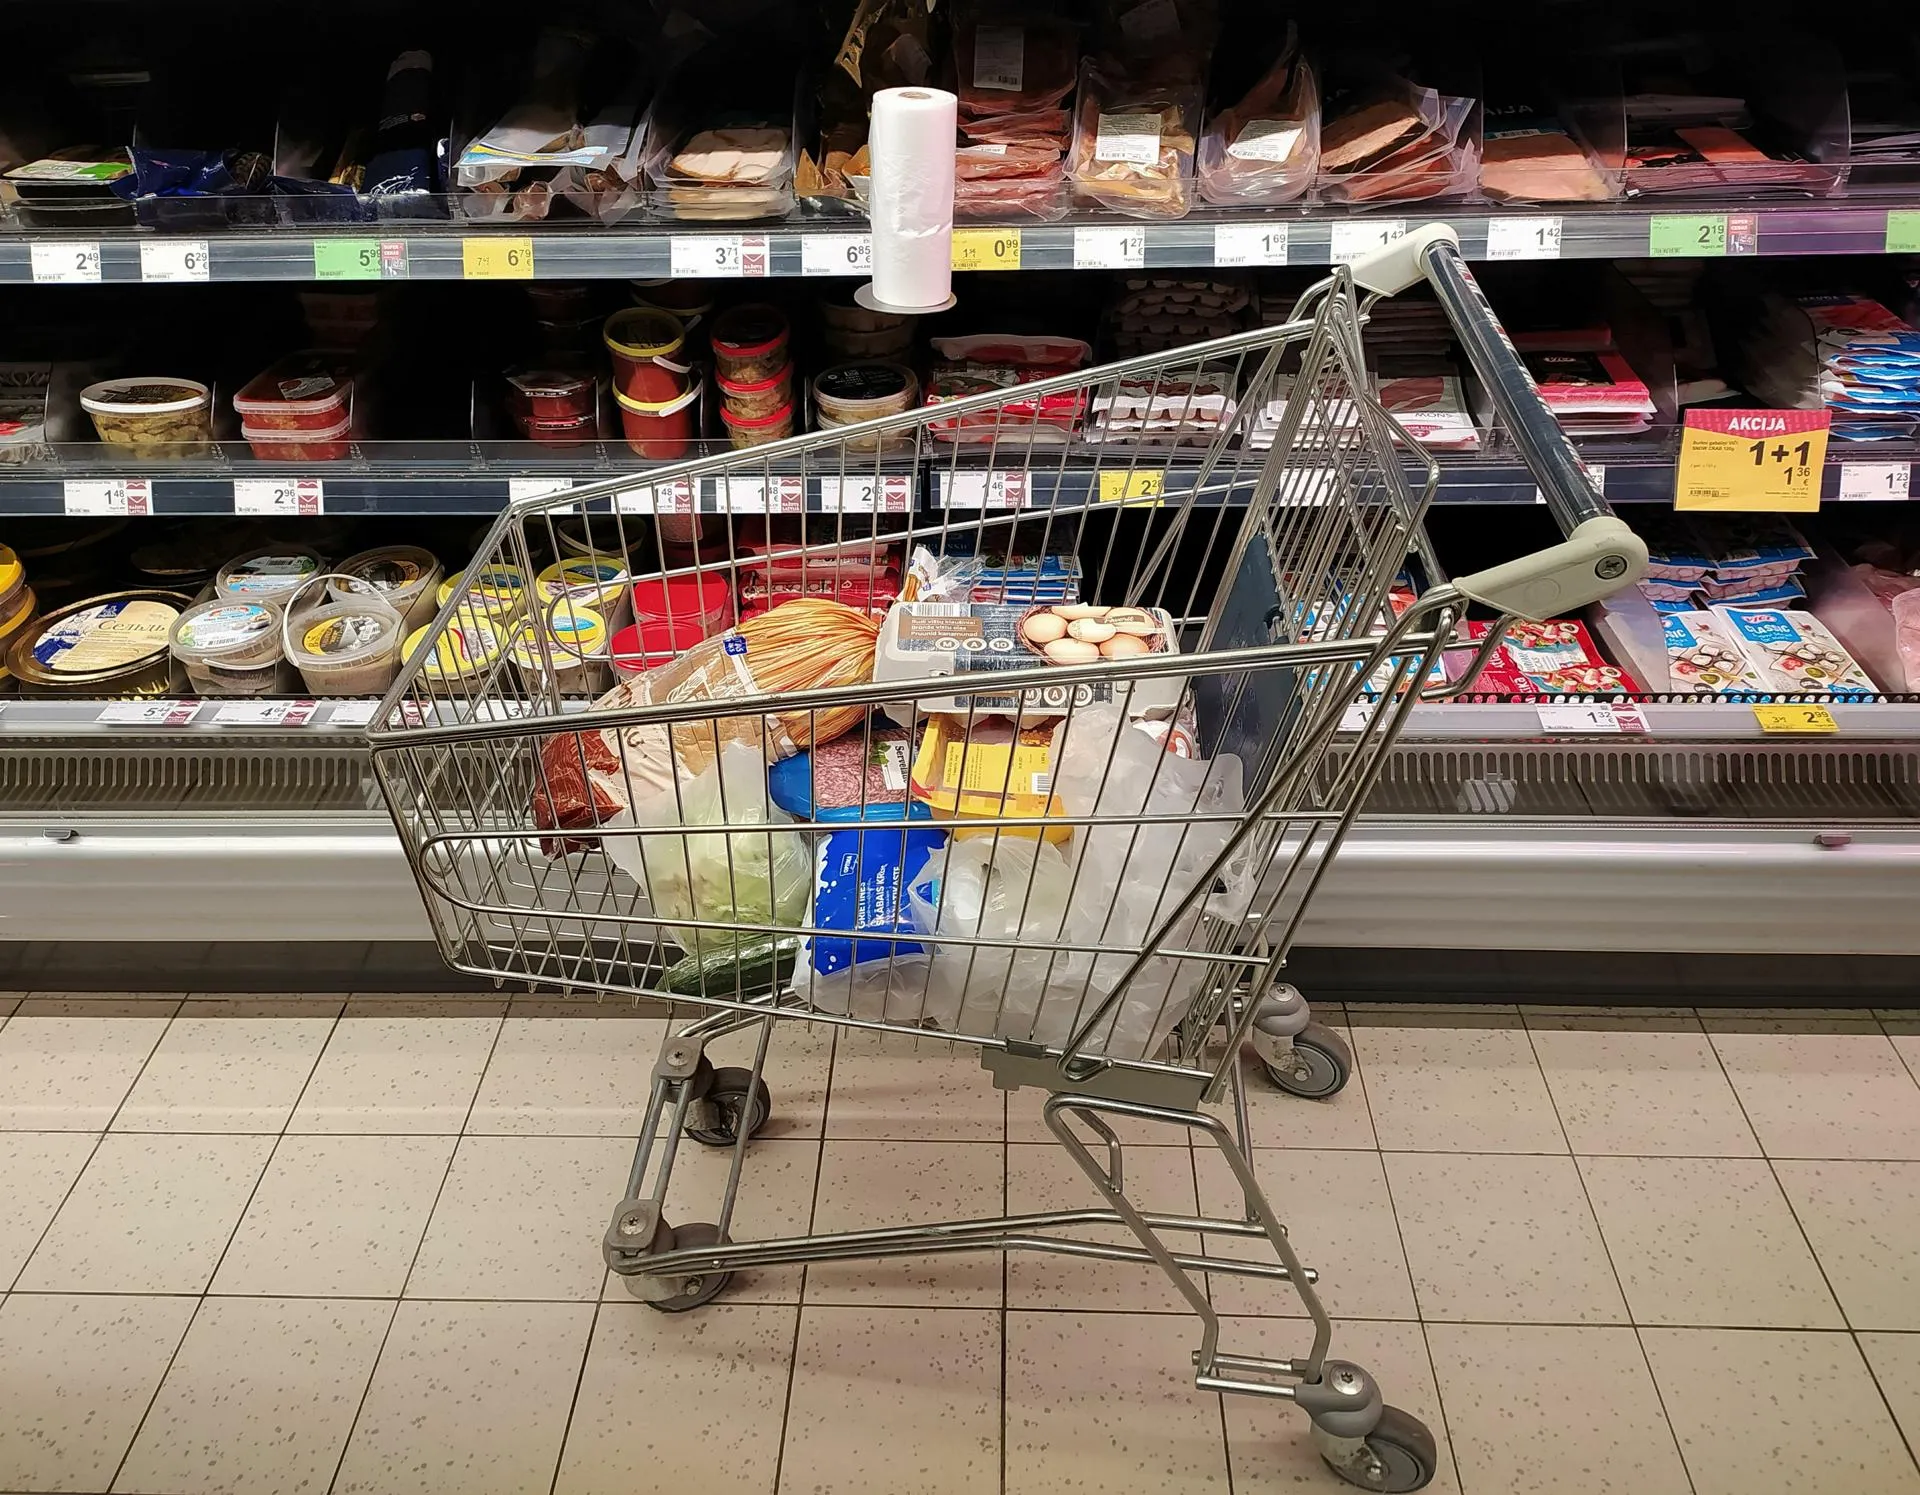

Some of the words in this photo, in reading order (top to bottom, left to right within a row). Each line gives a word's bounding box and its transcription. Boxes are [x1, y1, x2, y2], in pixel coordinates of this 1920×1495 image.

[1535, 228, 1560, 246] 142
[1698, 224, 1724, 243] 219
[994, 240, 1018, 257] 099
[1120, 238, 1143, 256] 127
[1262, 234, 1286, 253] 169
[76, 252, 98, 270] 249
[184, 252, 208, 270] 629
[359, 250, 381, 266] 599
[508, 250, 530, 266] 679
[716, 247, 738, 264] 371
[846, 246, 870, 263] 685
[1728, 417, 1786, 431] AKCIJA
[1749, 440, 1810, 466] 1+1
[1784, 467, 1811, 486] 136
[1886, 473, 1909, 489] 123
[104, 490, 125, 505] 148
[274, 490, 296, 504] 296
[1745, 624, 1790, 634] CLASSIC
[1587, 711, 1611, 722] 132
[1803, 711, 1828, 722] 299
